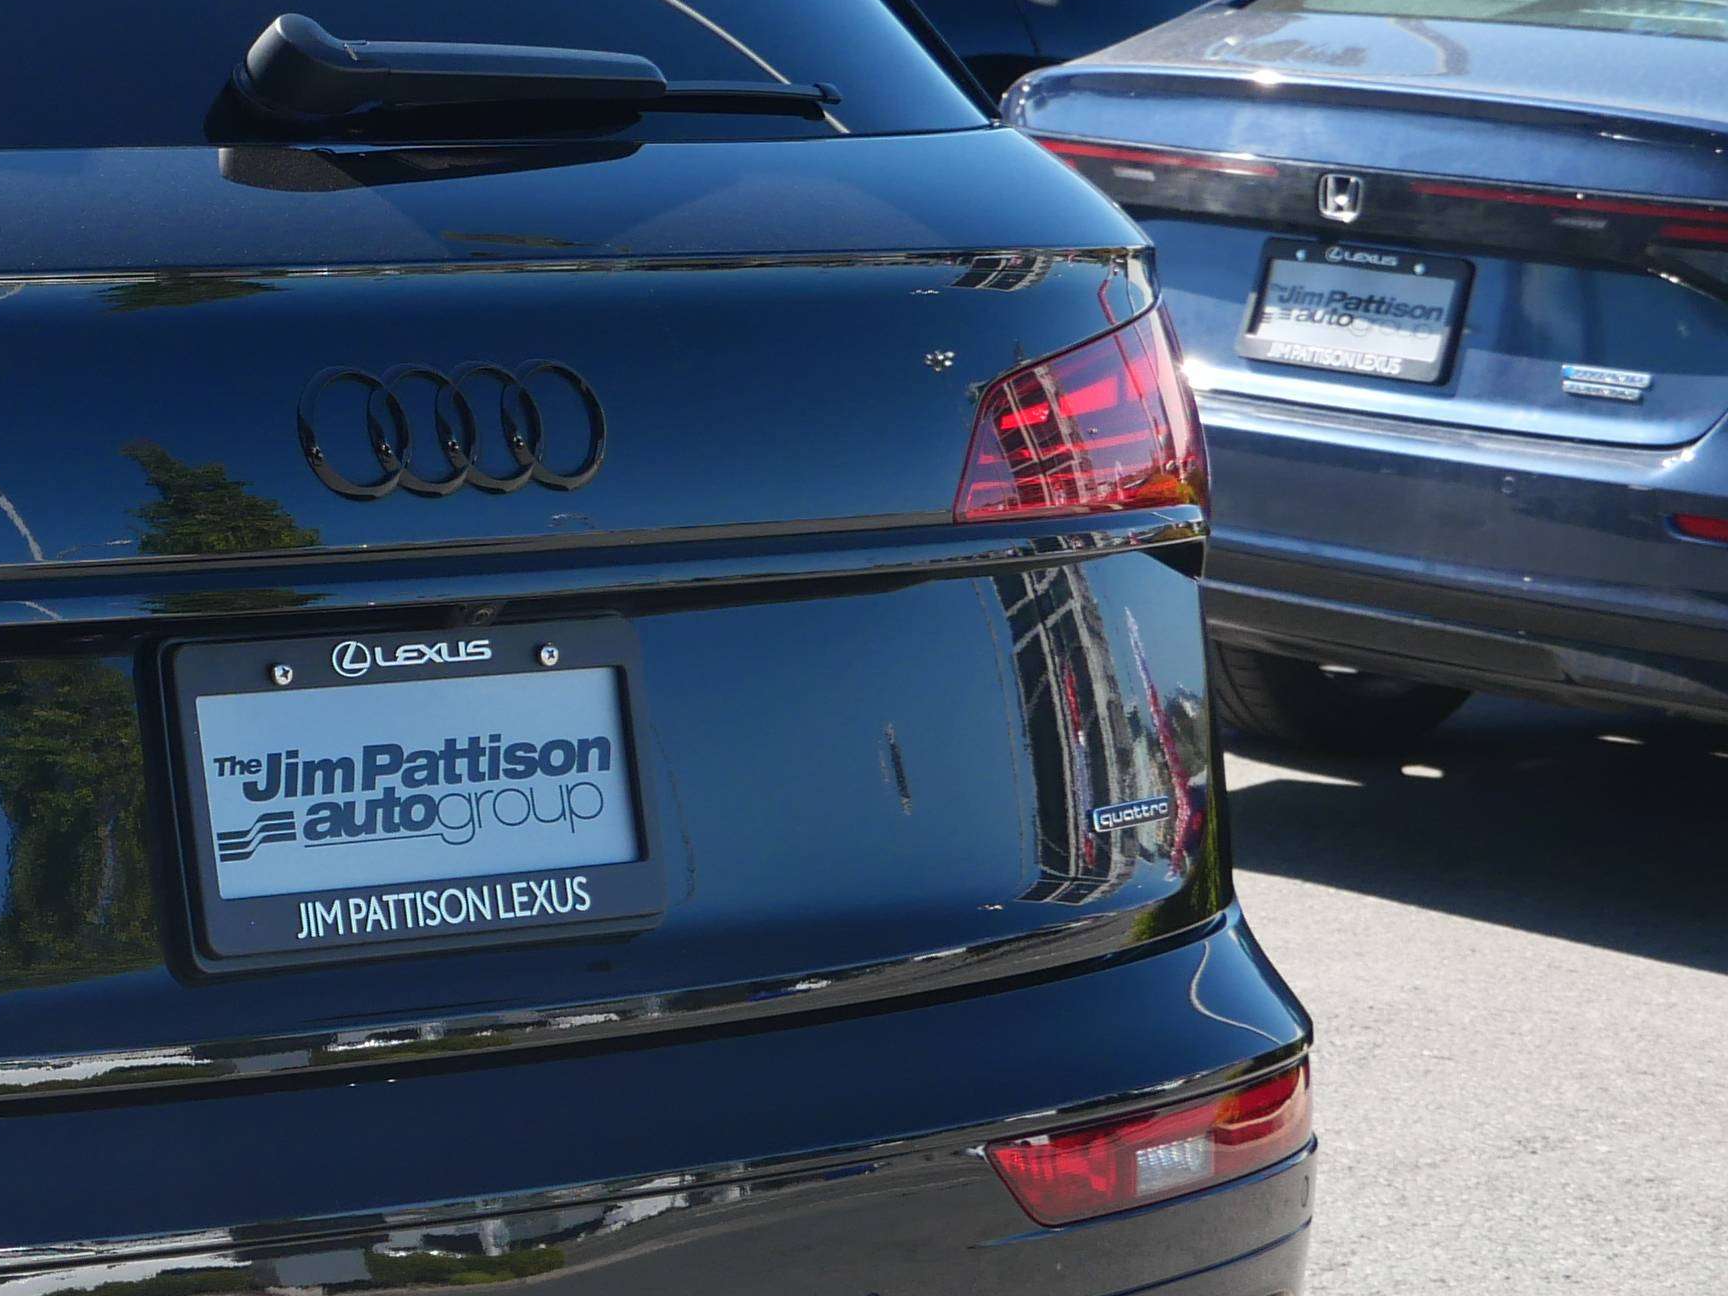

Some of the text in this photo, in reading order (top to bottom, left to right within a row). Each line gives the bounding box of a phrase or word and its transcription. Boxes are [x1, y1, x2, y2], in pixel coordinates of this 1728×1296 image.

[1345, 252, 1398, 267] LEXUS
[1327, 290, 1443, 322] Pattison
[1293, 345, 1355, 370] PATTISON
[376, 639, 492, 667] LEXUS
[213, 733, 612, 802] The Jim Pattison
[1100, 801, 1169, 828] quattro
[297, 876, 591, 940] JIM PATTISON LEXUS
